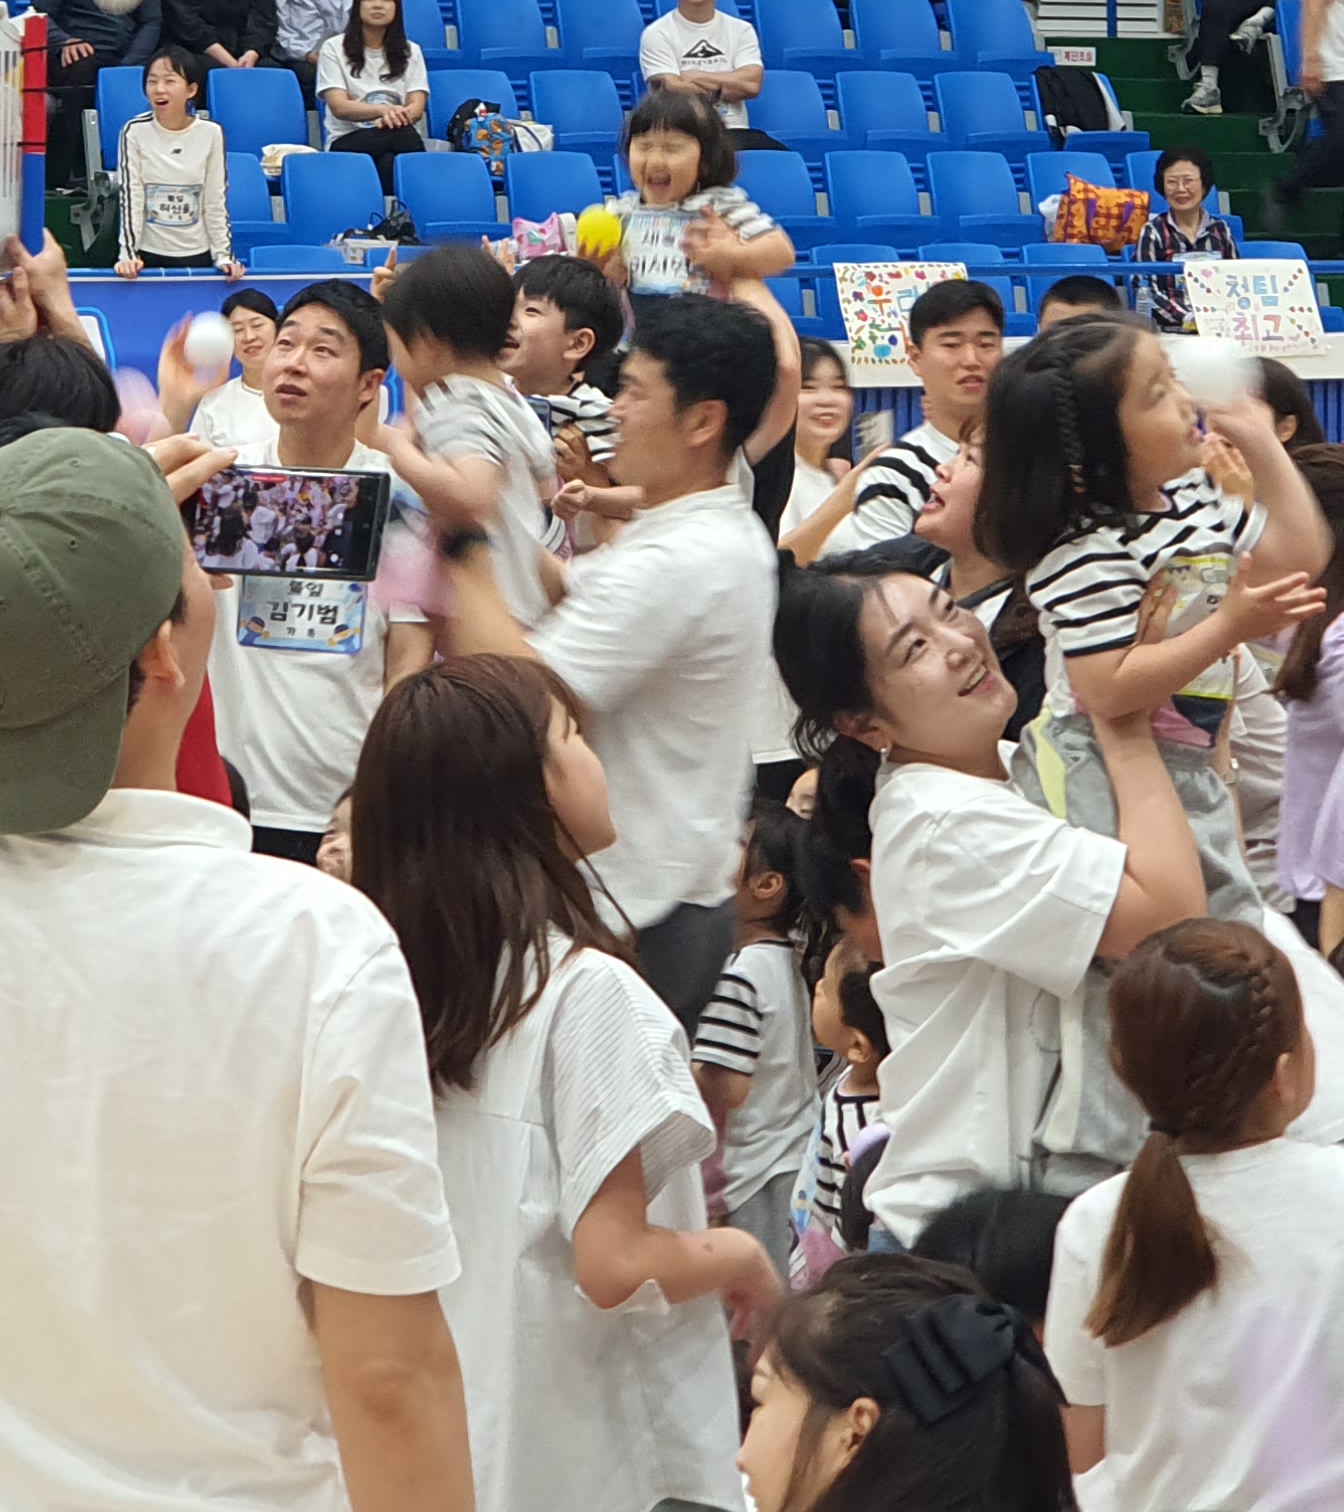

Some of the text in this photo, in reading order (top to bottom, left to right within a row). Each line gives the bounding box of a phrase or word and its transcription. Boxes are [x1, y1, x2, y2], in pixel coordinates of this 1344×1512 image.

[1224, 273, 1280, 310] 청팀
[1231, 311, 1286, 342] 최고
[266, 600, 339, 626] 김기범
